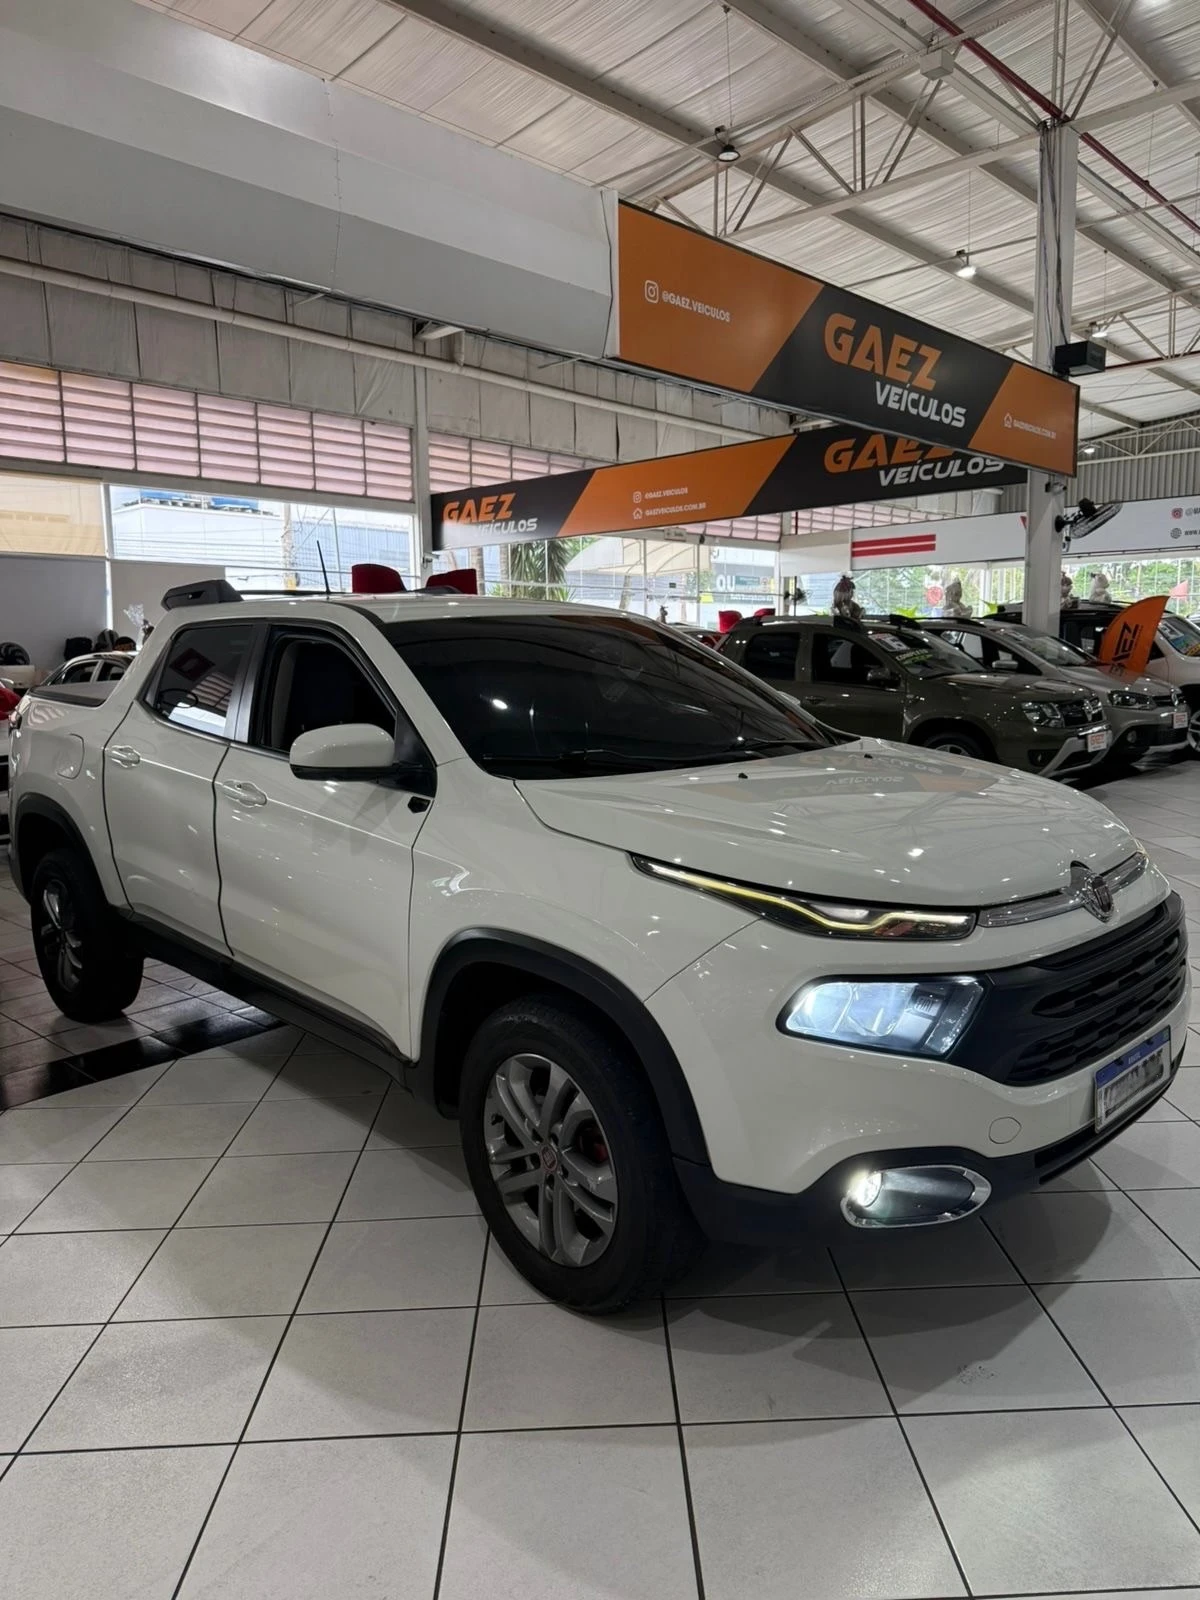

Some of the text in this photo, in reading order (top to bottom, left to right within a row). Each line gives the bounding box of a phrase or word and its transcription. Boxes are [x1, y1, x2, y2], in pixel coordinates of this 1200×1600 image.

[662, 291, 731, 322] @GAEZ.VEICULOS
[824, 312, 942, 391] GAEZ
[875, 381, 967, 428] VEÍCULOS
[442, 493, 516, 524] GAEZ
